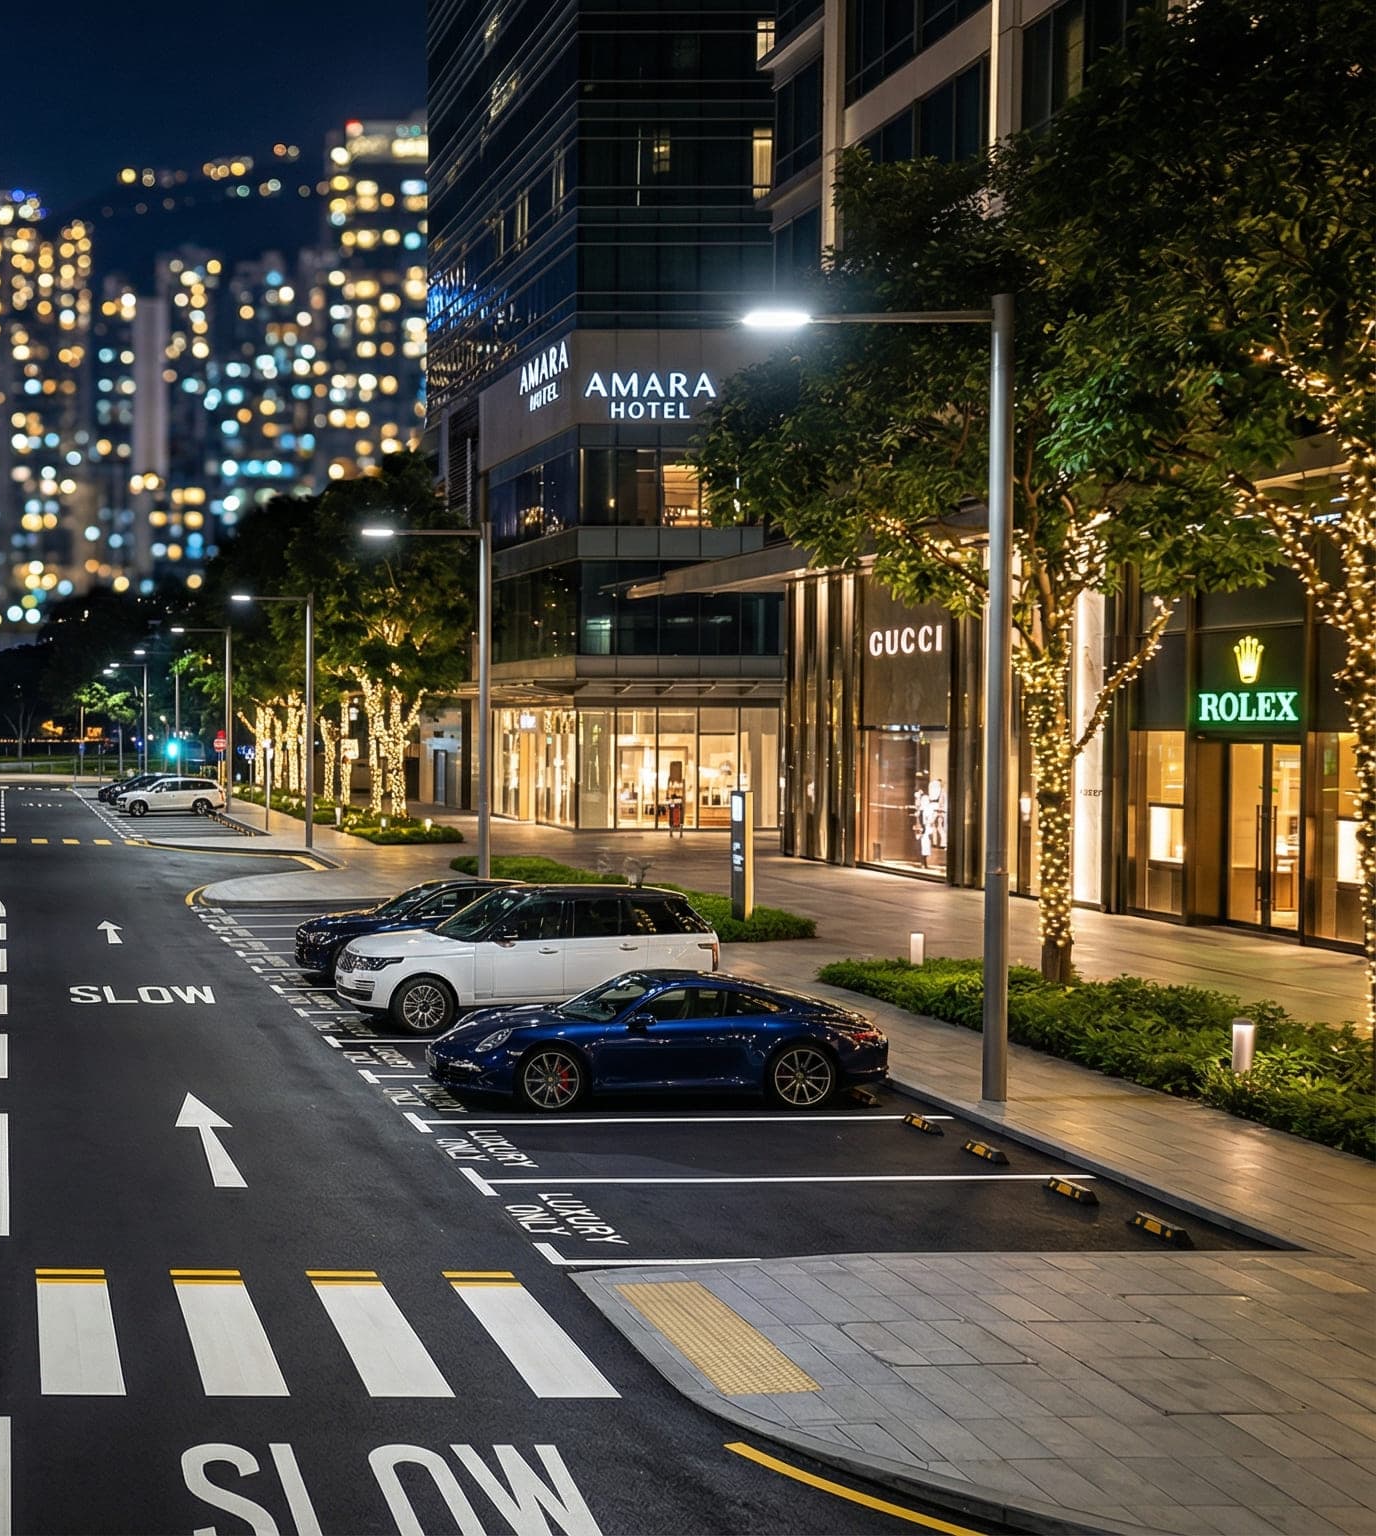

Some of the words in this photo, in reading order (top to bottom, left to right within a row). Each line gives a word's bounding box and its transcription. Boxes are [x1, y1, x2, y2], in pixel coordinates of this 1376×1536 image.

[519, 340, 569, 396] AMARA
[584, 371, 717, 398] AMARA
[610, 401, 691, 420] HOTEL
[869, 625, 943, 657] GUCCI
[1198, 691, 1299, 721] ROLEX
[69, 985, 217, 1004] SLOW
[435, 1138, 490, 1162] ONLY
[467, 1129, 540, 1169] LUXURY
[505, 1204, 572, 1237] ONLY
[537, 1193, 630, 1246] LUXURY
[181, 1442, 604, 1536] SLOW
